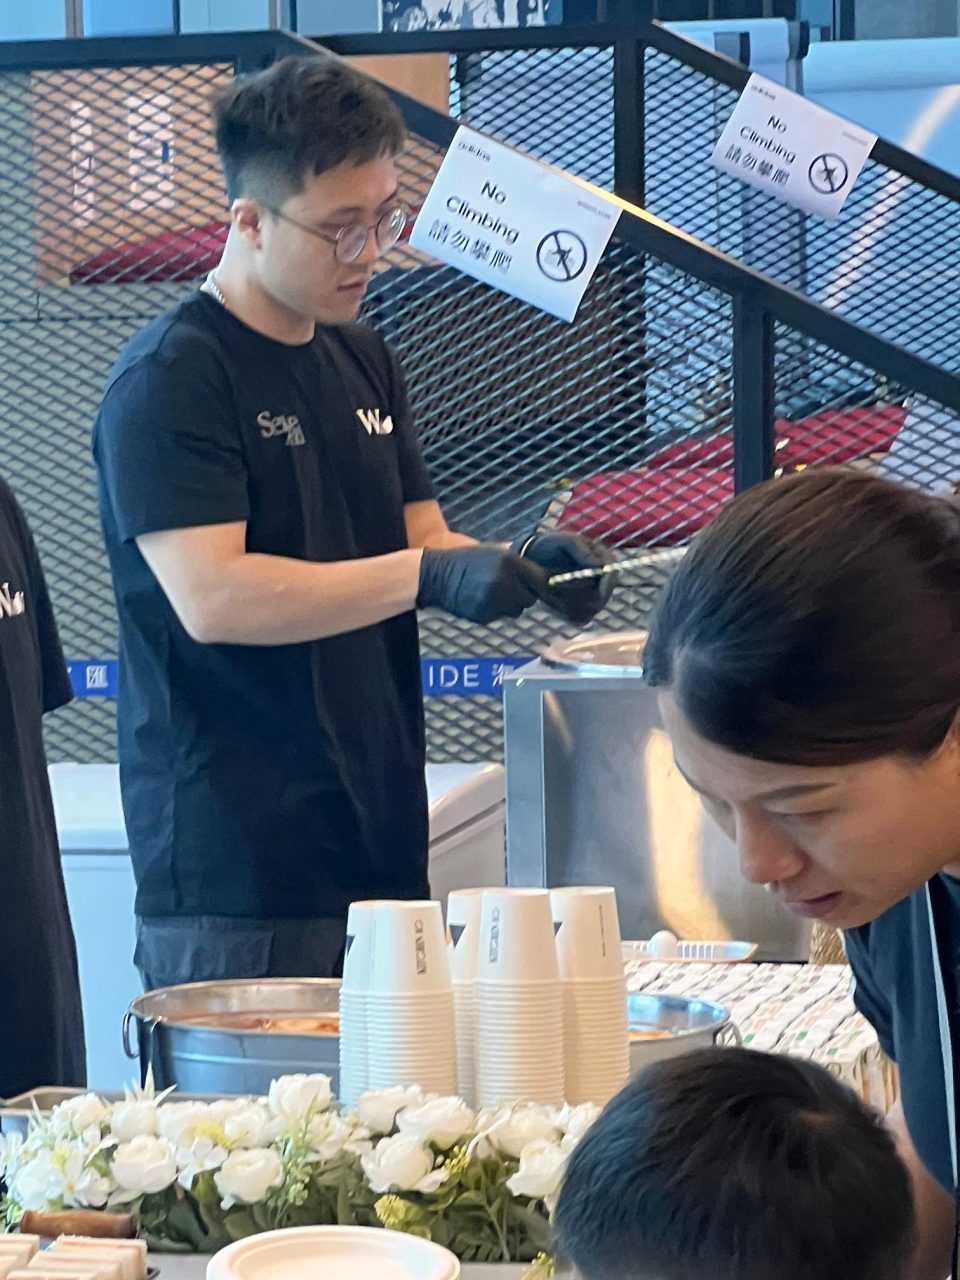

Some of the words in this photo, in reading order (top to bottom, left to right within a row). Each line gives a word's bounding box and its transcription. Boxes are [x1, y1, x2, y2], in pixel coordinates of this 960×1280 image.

[767, 115, 788, 134] No
[740, 126, 797, 165] Climbing
[481, 180, 507, 204] No
[446, 195, 520, 246] Climbing
